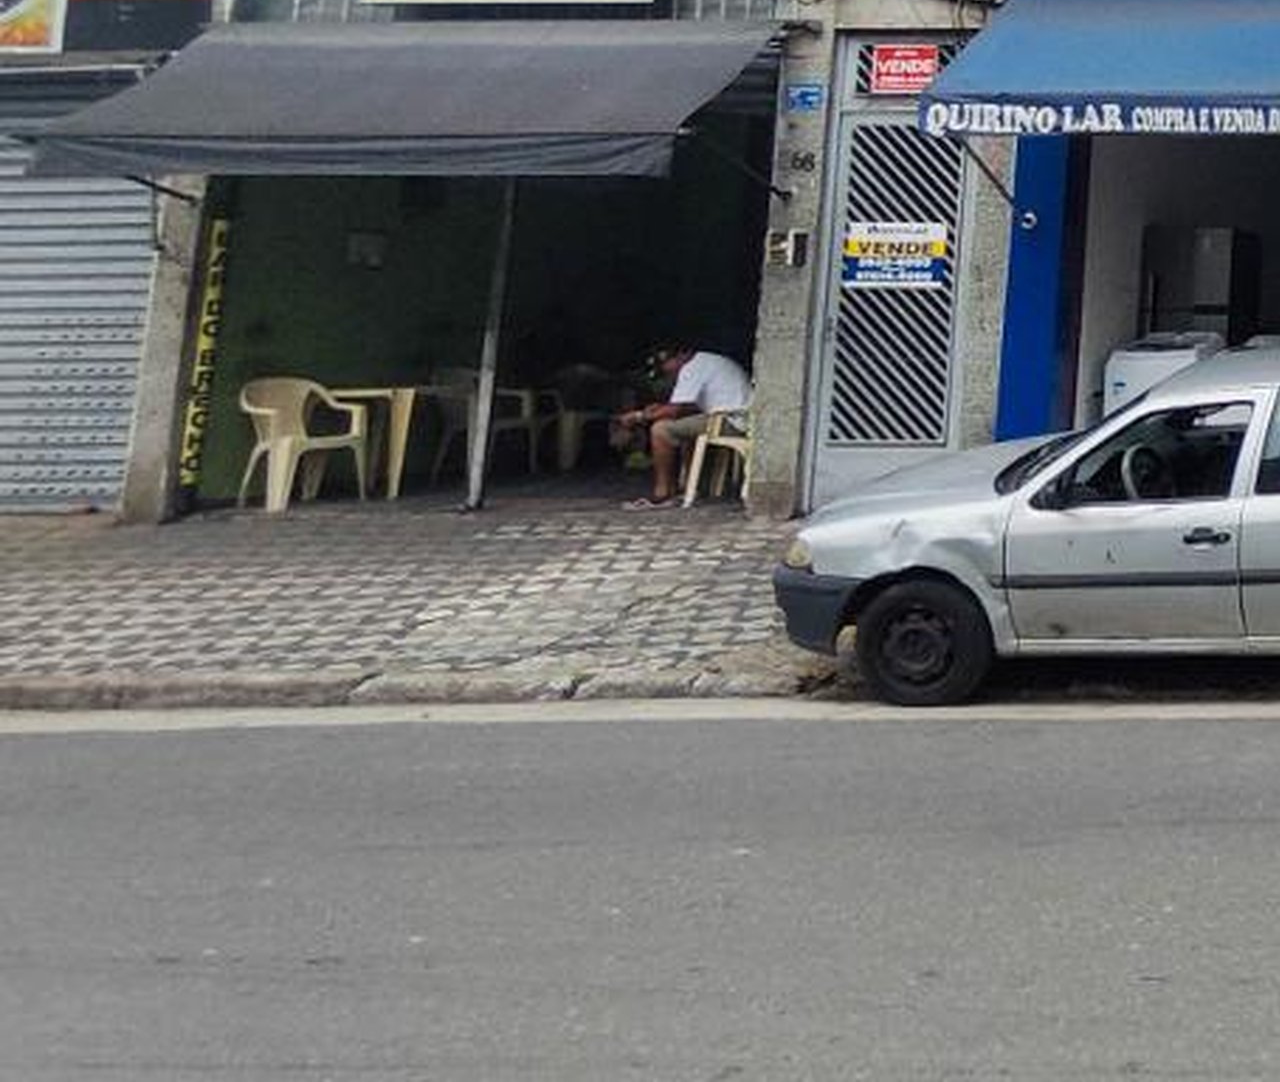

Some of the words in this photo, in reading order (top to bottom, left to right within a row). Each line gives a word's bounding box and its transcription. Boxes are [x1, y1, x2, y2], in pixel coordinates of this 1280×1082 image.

[877, 60, 935, 75] VENDE
[925, 104, 1055, 136] QUIRINO
[1062, 104, 1124, 132] LAR
[1132, 108, 1198, 133] COMPRA
[1200, 108, 1210, 133] E
[1211, 108, 1265, 133] VENDA
[858, 241, 930, 256] VENDE
